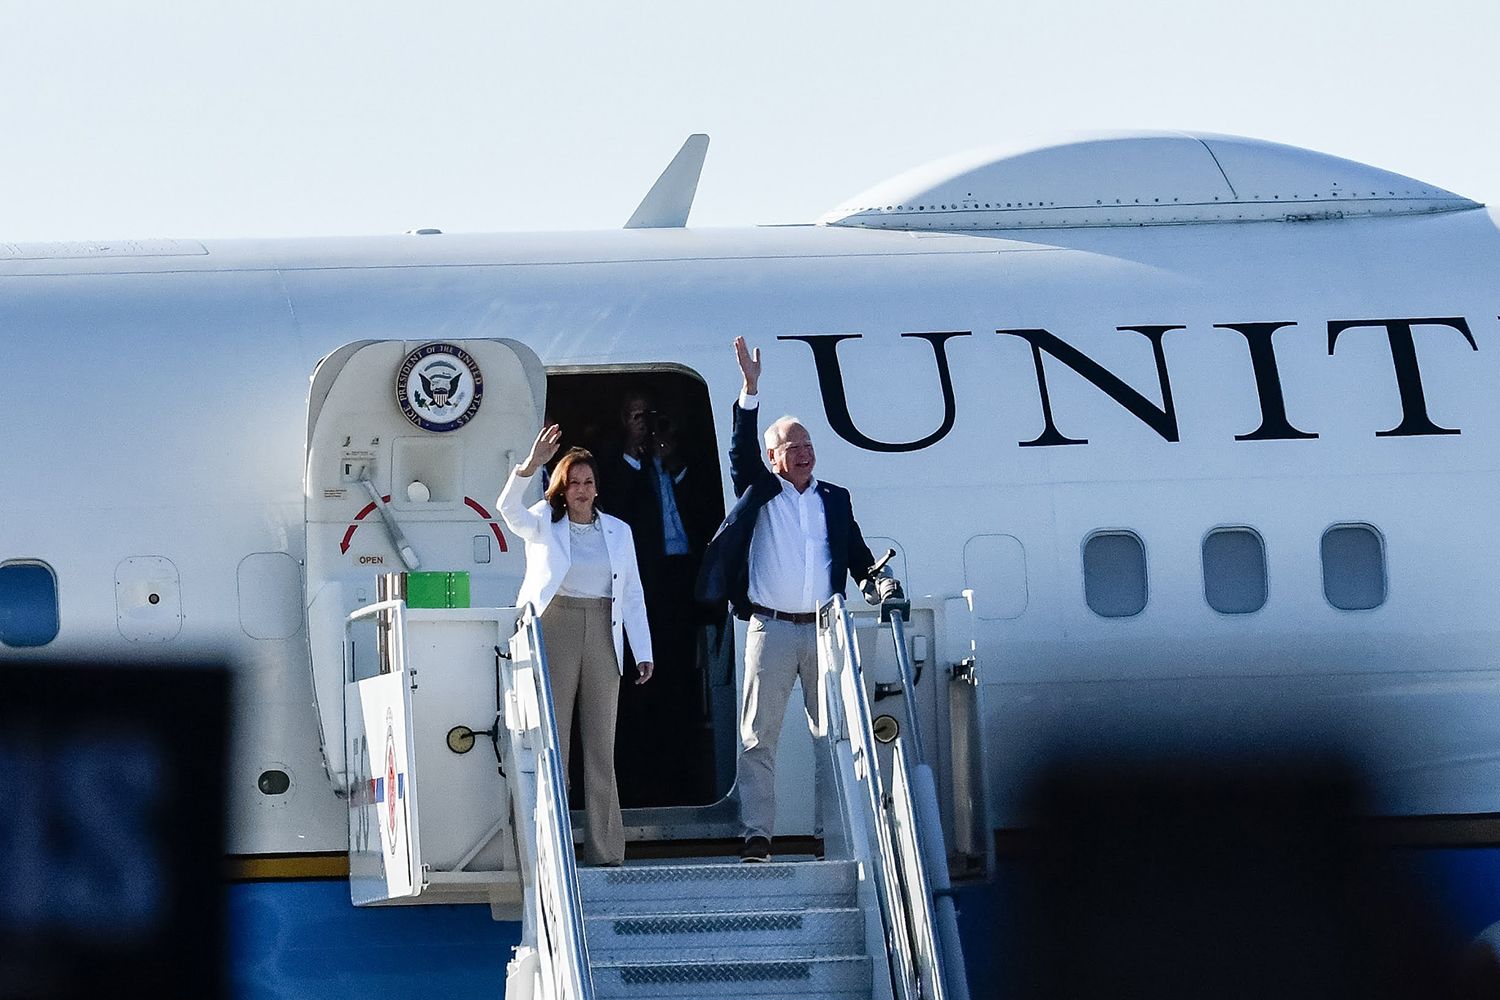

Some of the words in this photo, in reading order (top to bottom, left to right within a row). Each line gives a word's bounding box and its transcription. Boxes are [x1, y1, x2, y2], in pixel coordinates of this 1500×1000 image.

[440, 345, 453, 353] THE
[398, 352, 423, 401] PRESIDENT
[457, 350, 483, 385] UNITED
[403, 404, 421, 426] VICE
[457, 393, 481, 425] STATES
[359, 556, 384, 564] OPEN
